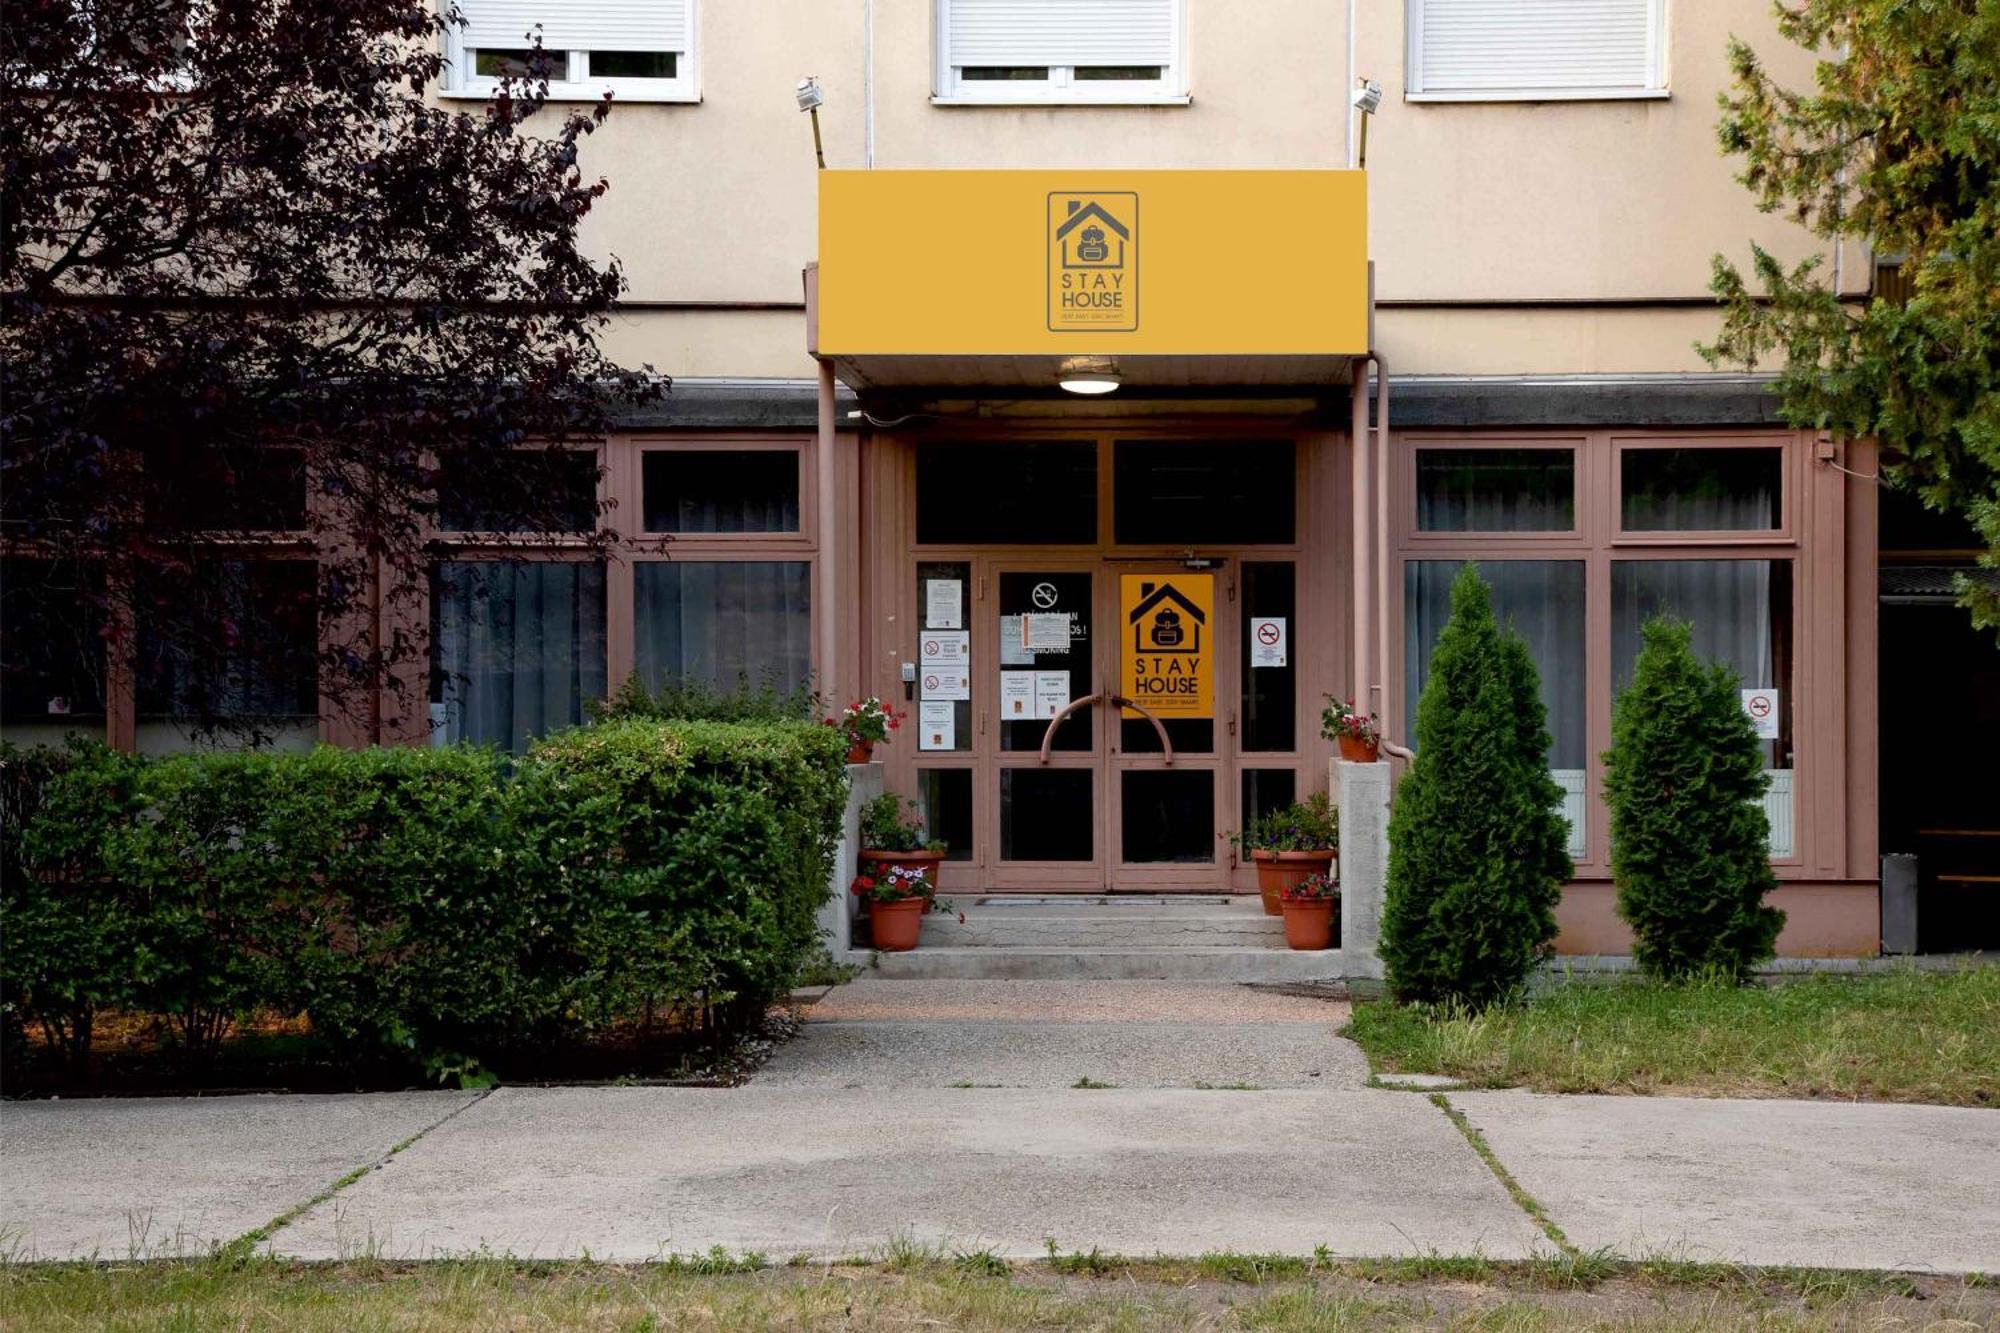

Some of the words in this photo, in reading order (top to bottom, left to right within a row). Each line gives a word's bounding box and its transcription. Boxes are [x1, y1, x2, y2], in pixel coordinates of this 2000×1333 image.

[1062, 273, 1123, 289] STAY
[1062, 292, 1123, 308] HOUSE
[1135, 658, 1200, 675] STAY
[1135, 677, 1199, 694] HOUSE
